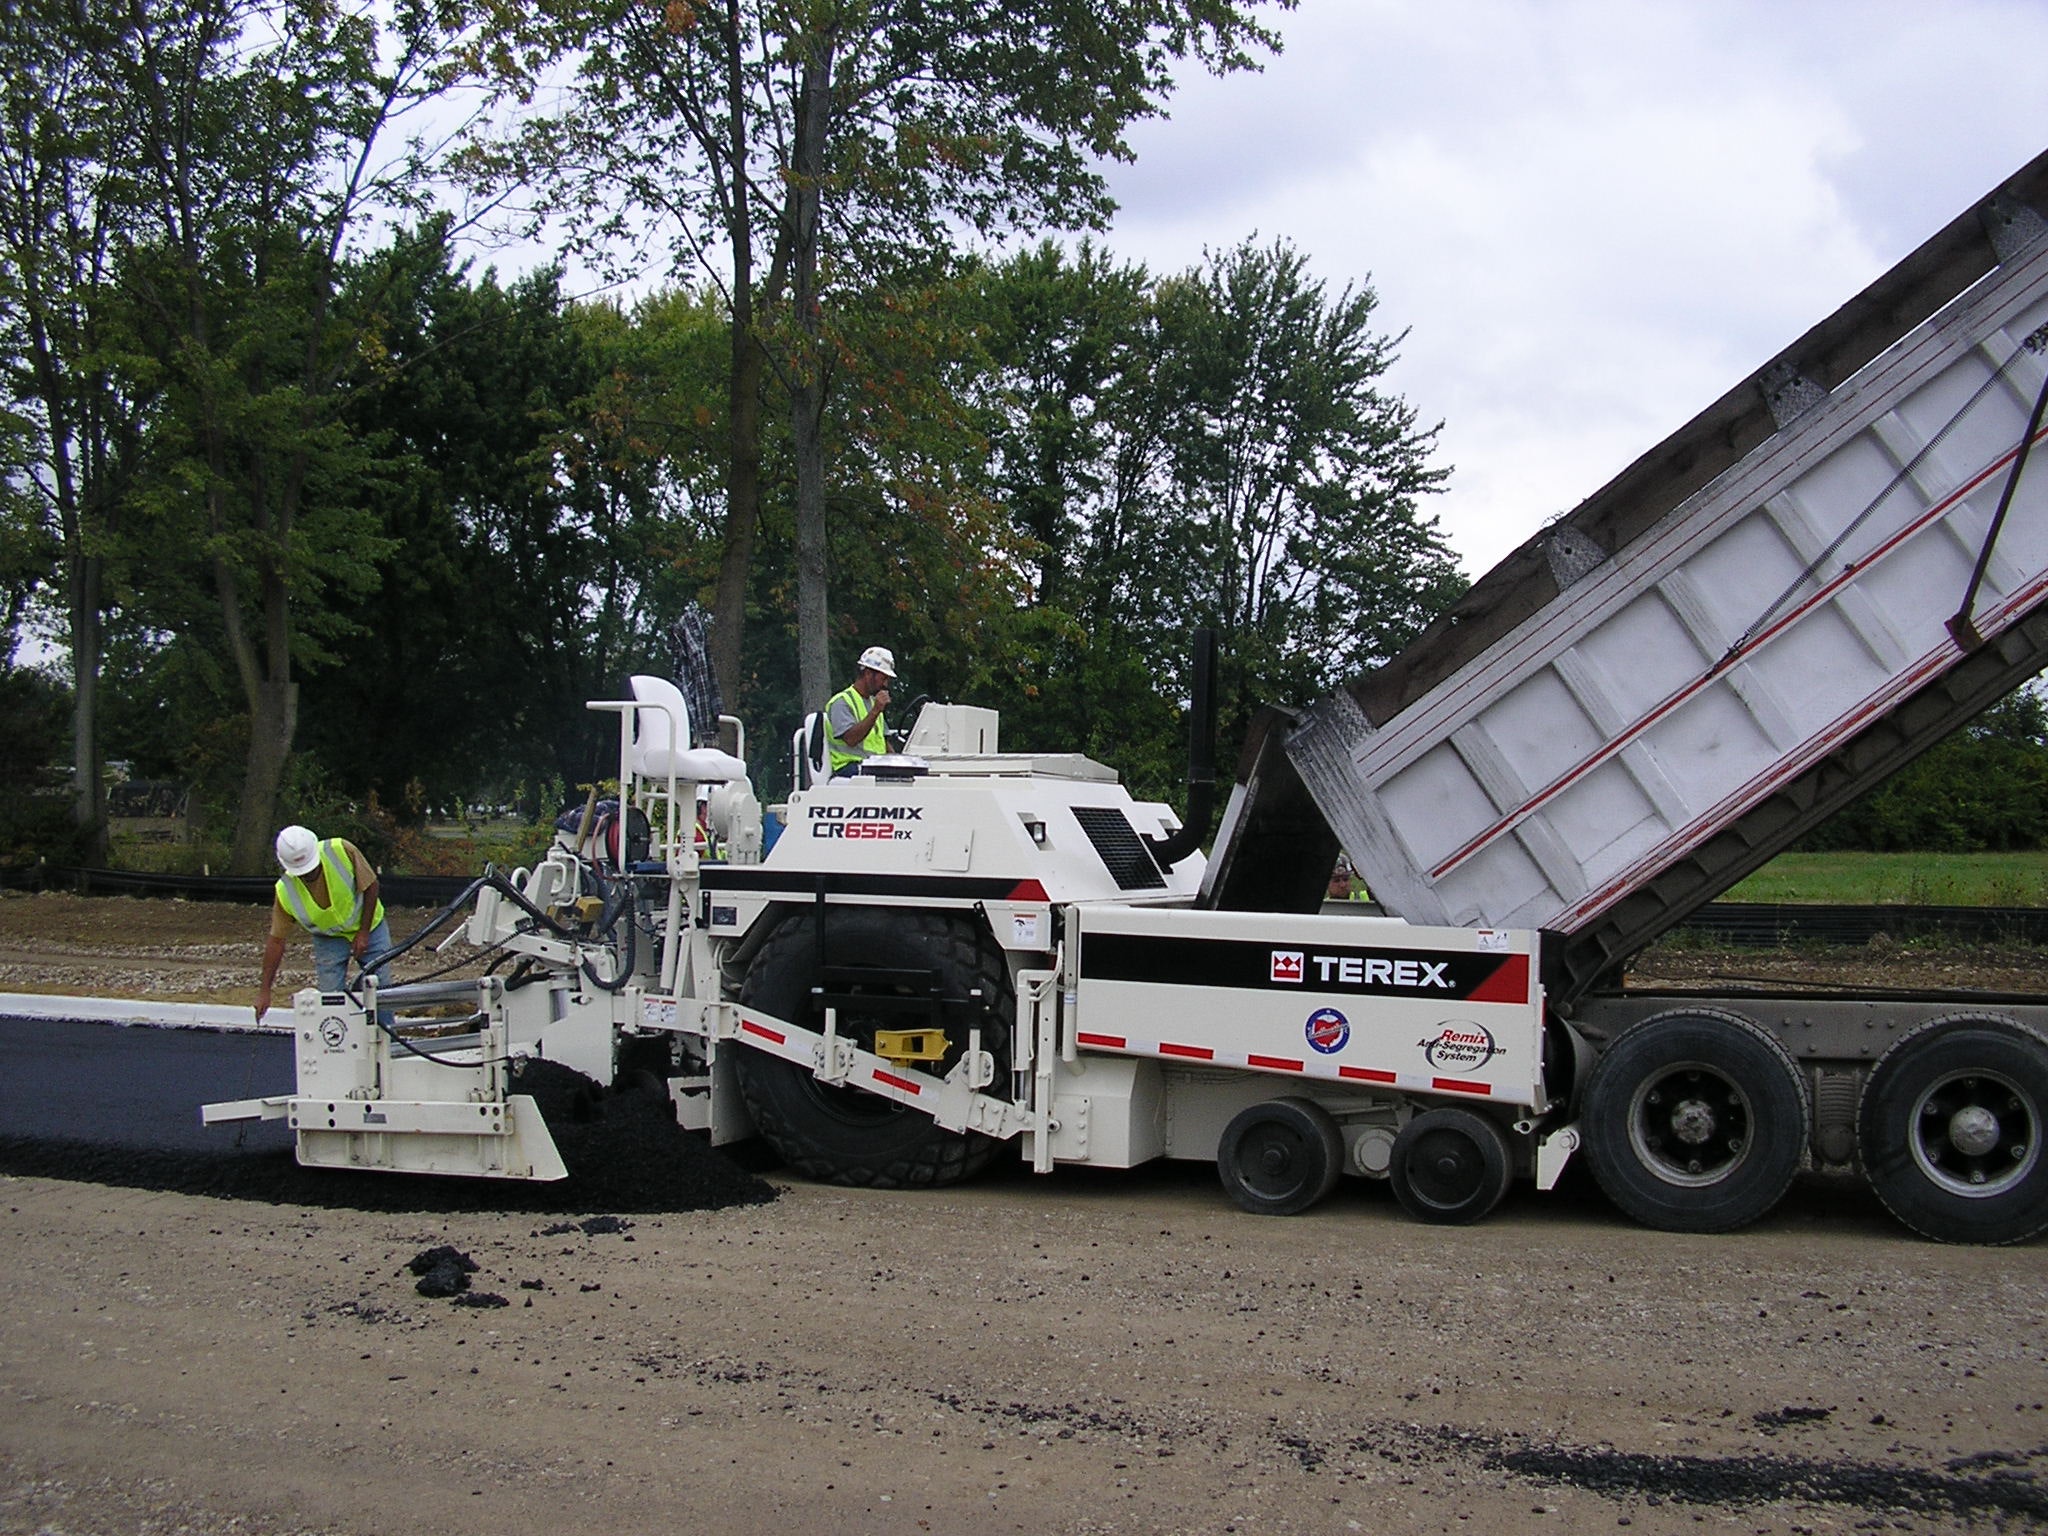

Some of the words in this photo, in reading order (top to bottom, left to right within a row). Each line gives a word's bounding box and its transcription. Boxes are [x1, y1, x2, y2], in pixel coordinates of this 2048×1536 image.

[808, 806, 923, 819] ROADMIX
[1313, 956, 1448, 988] TEREX
[1441, 1029, 1487, 1044] Remix
[1437, 1050, 1477, 1062] System
